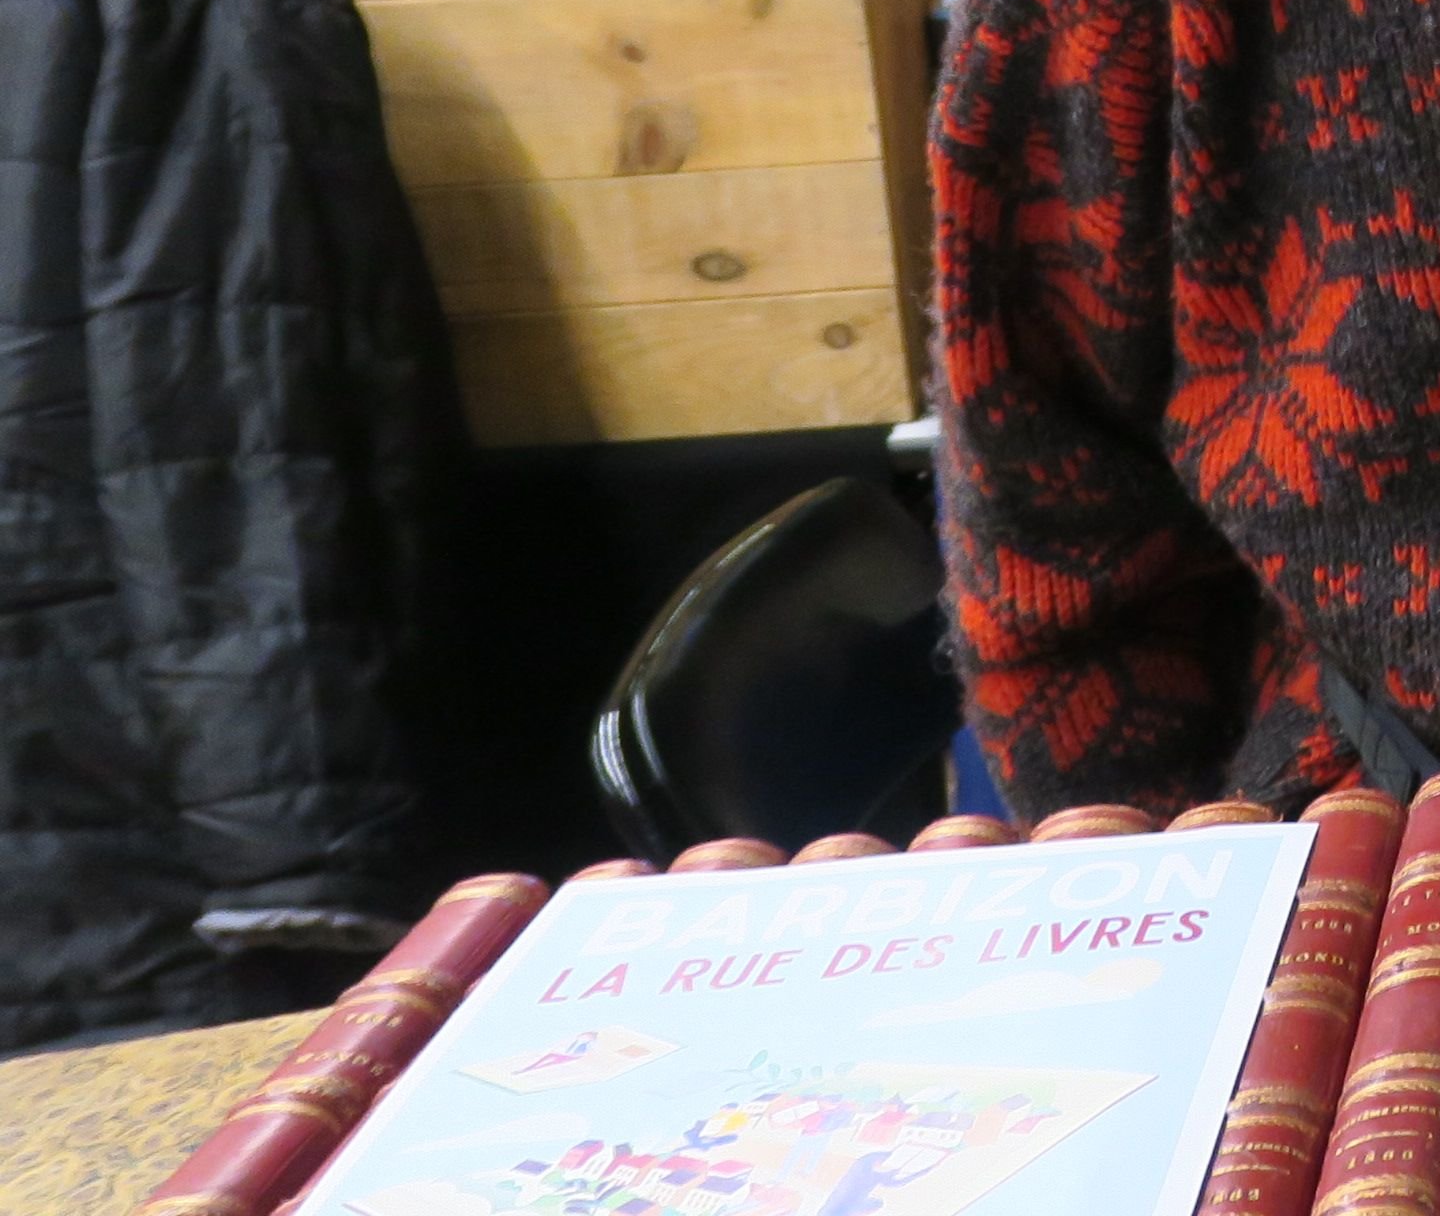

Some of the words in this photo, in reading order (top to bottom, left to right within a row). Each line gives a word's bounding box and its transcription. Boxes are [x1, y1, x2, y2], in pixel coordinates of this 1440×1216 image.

[578, 848, 1233, 956] BARBIZON
[538, 961, 630, 1004] LA
[659, 948, 803, 995] RUE
[821, 934, 955, 980] DES
[978, 909, 1211, 964] LIVRES
